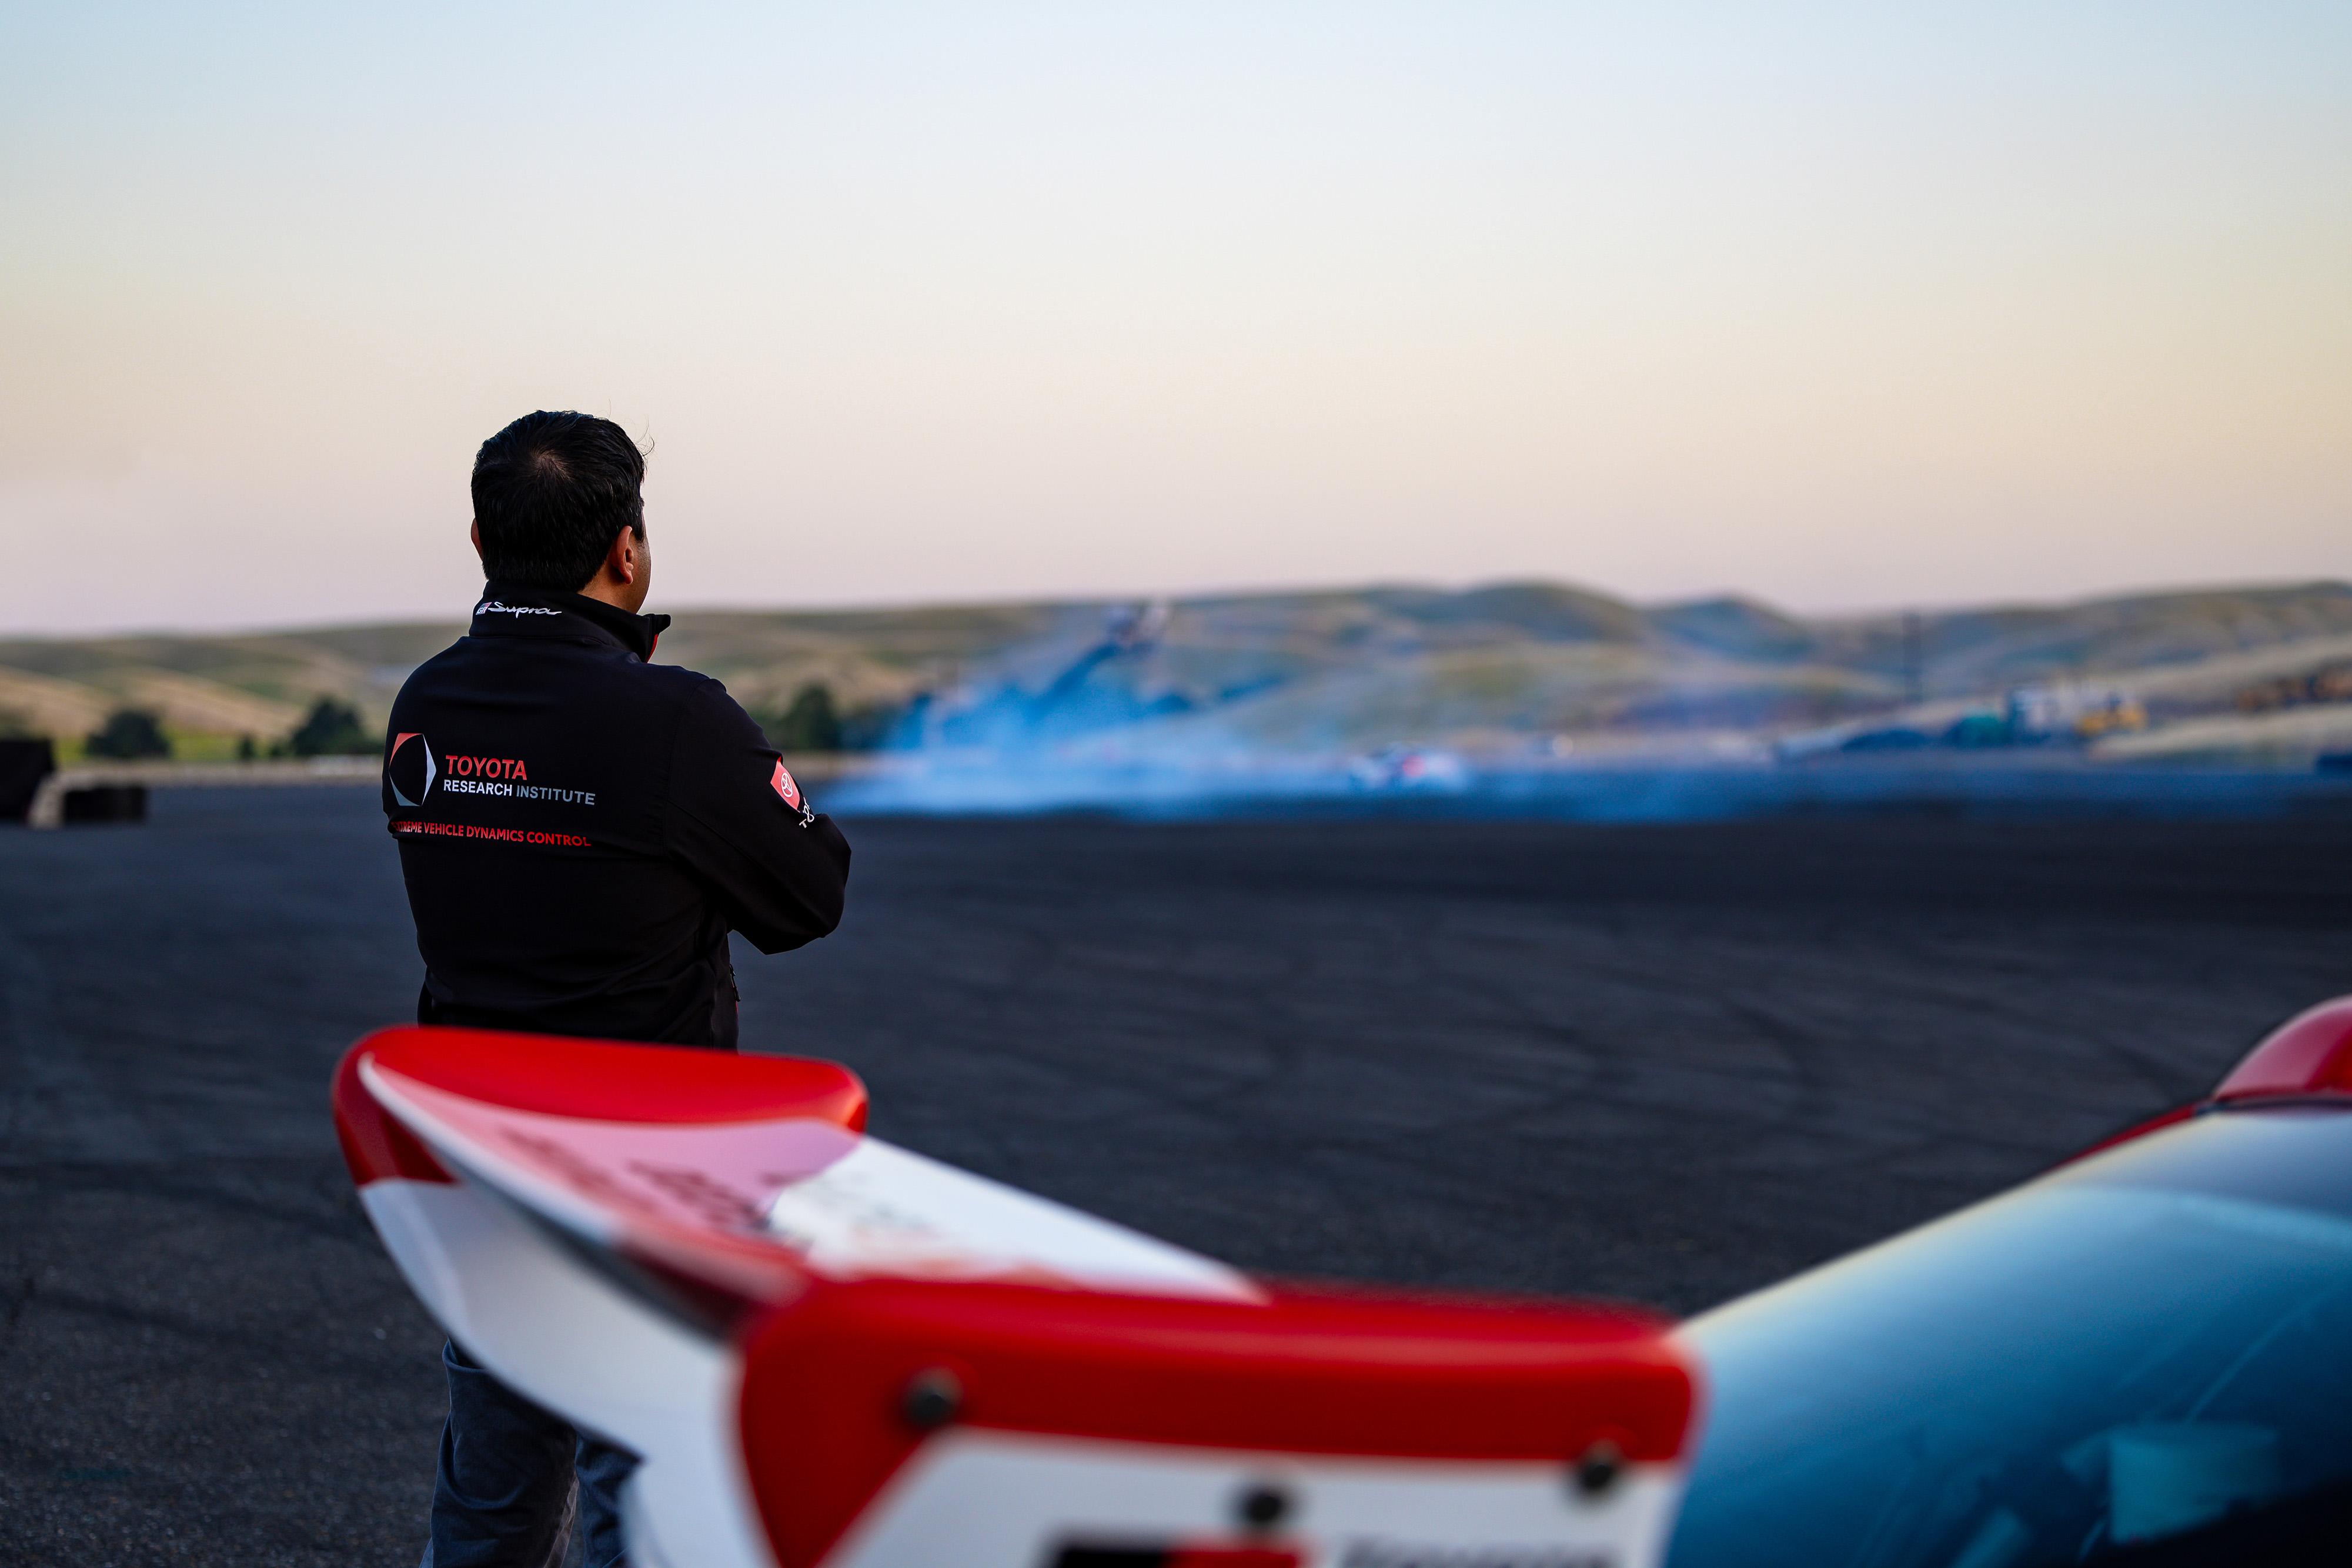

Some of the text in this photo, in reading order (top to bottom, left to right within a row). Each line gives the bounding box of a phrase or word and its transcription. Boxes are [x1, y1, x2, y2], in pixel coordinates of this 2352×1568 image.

[487, 601, 562, 618] Supra
[445, 755, 527, 780] TOYOTA
[443, 779, 596, 805] RESEARCH INSTITUTE
[424, 822, 464, 837] VEHICLE
[466, 825, 524, 842] DYNAMICS
[527, 831, 592, 847] CONTROL
